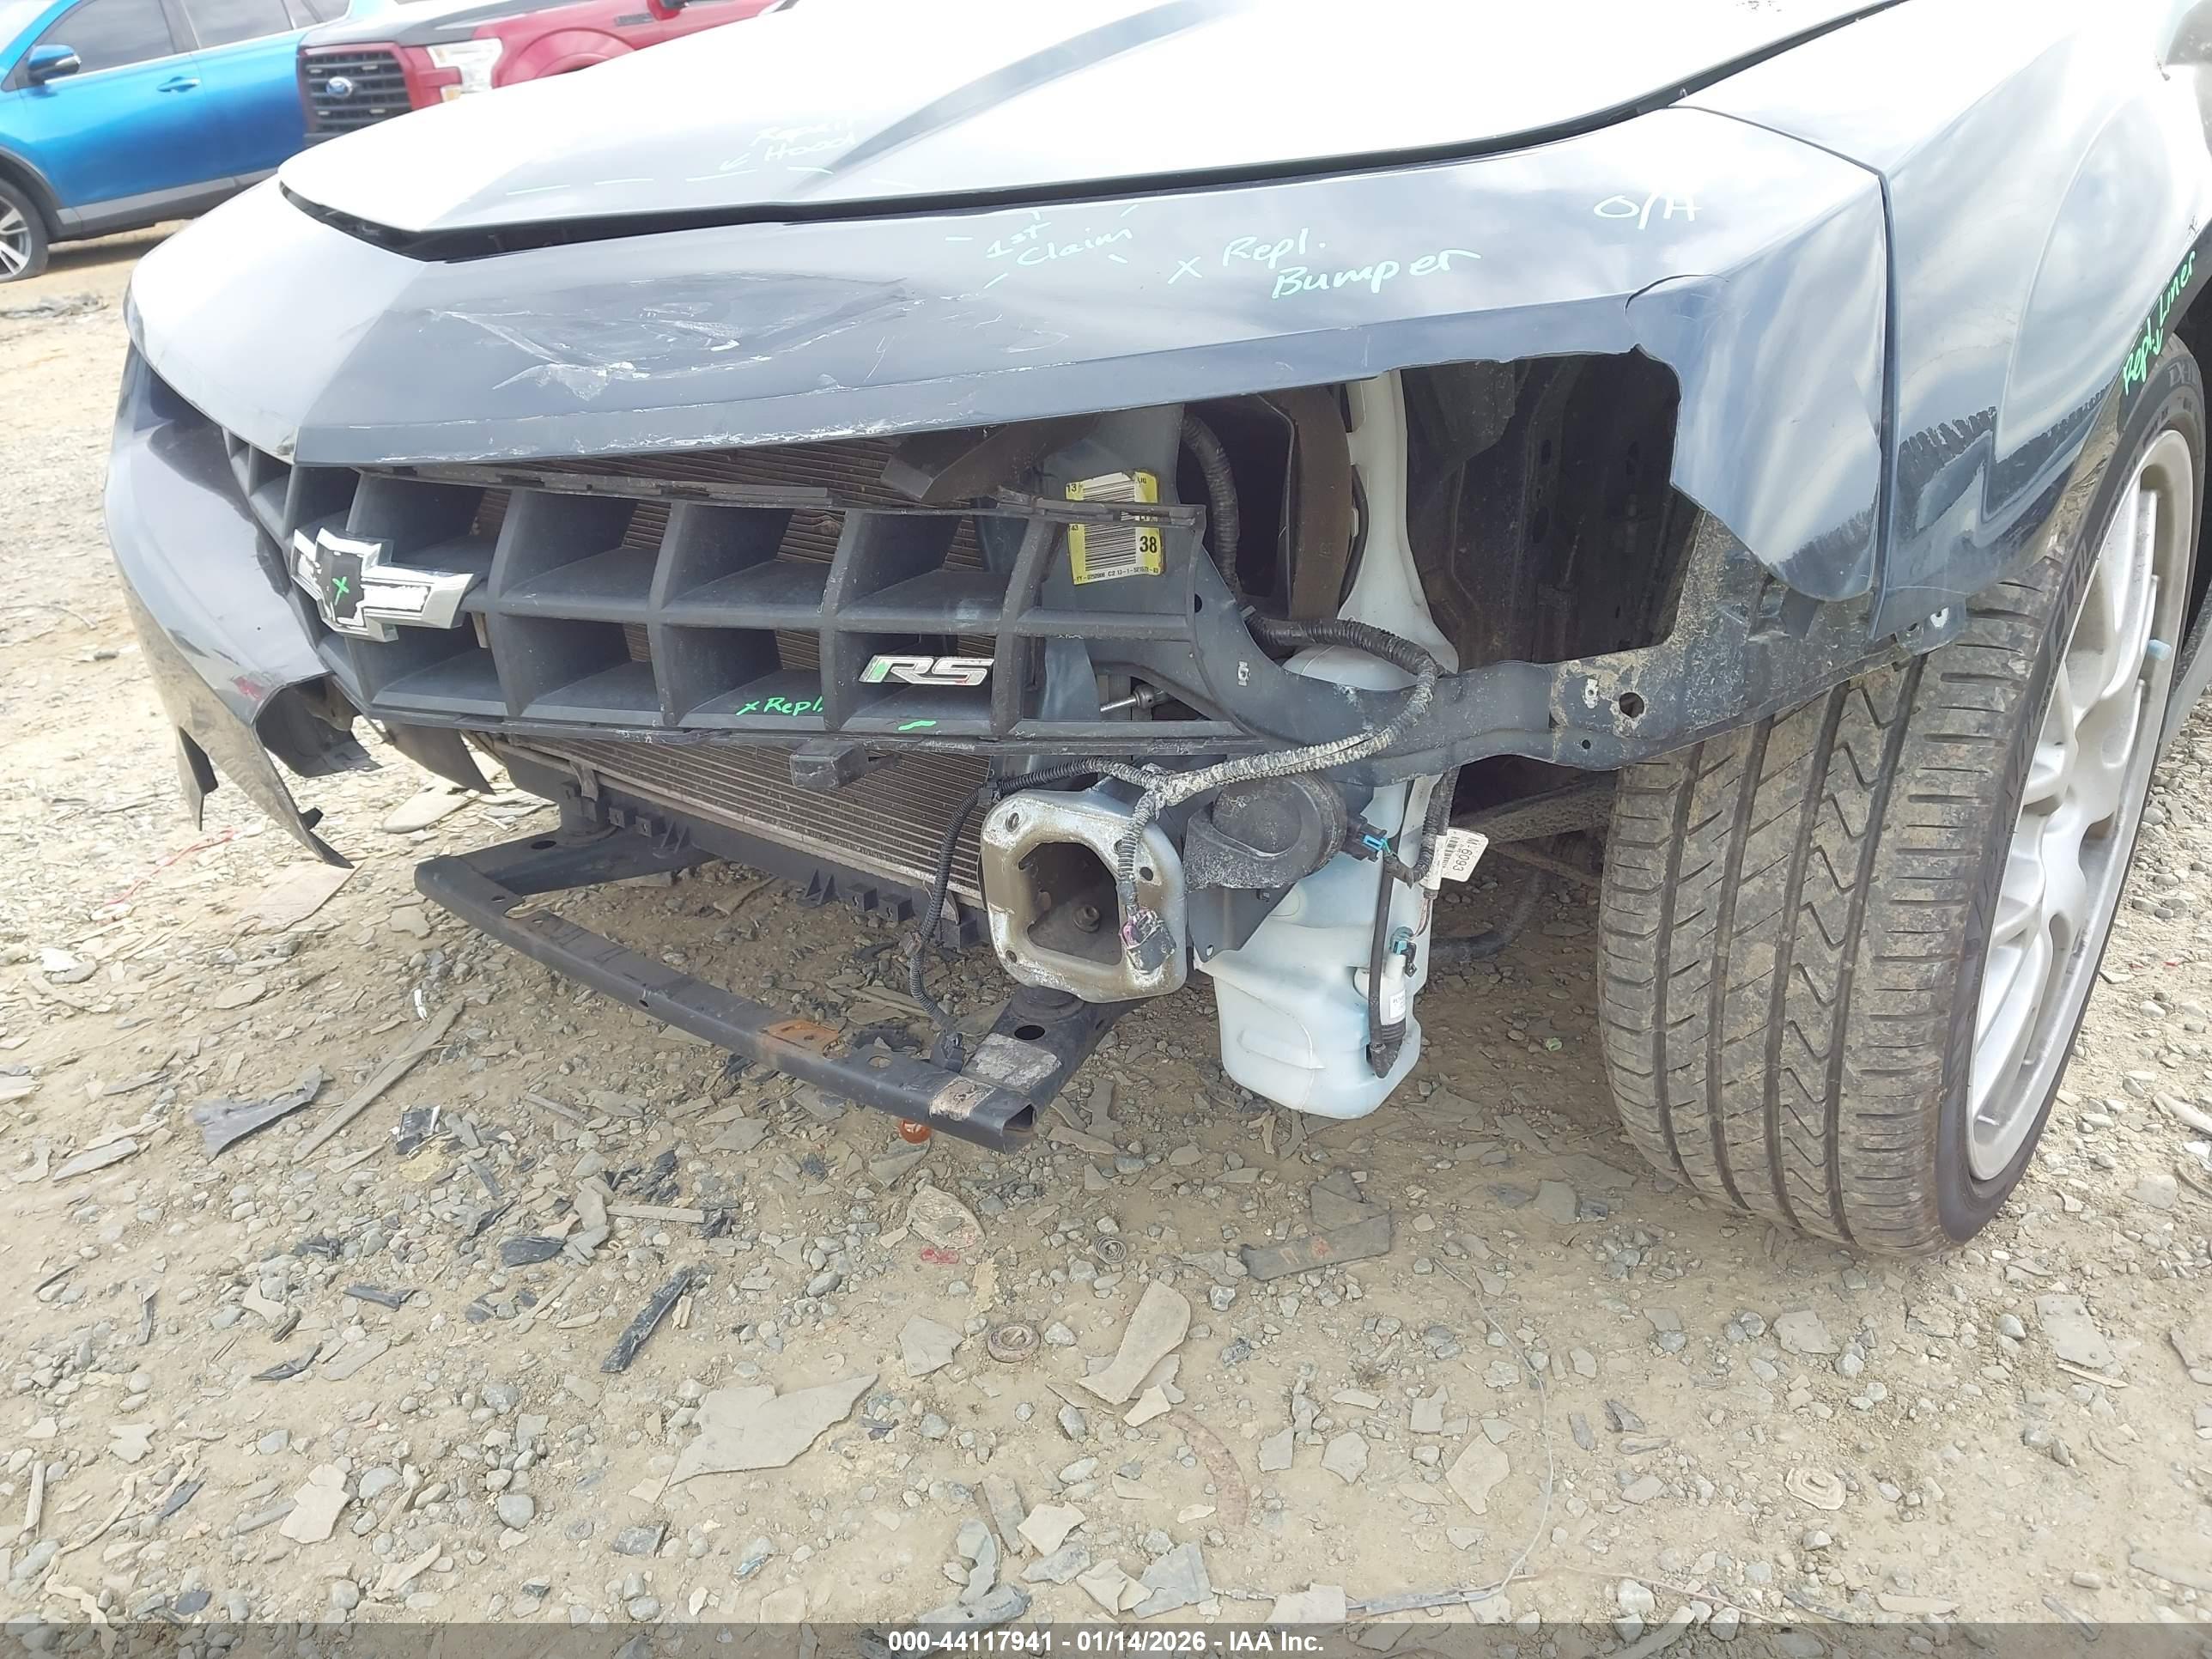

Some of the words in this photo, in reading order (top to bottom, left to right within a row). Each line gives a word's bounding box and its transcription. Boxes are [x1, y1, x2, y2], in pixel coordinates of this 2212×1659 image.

[1017, 228, 1133, 266] Claim
[1272, 249, 1482, 300] Bumper
[1139, 536, 1158, 553] 38
[859, 654, 994, 686] RS
